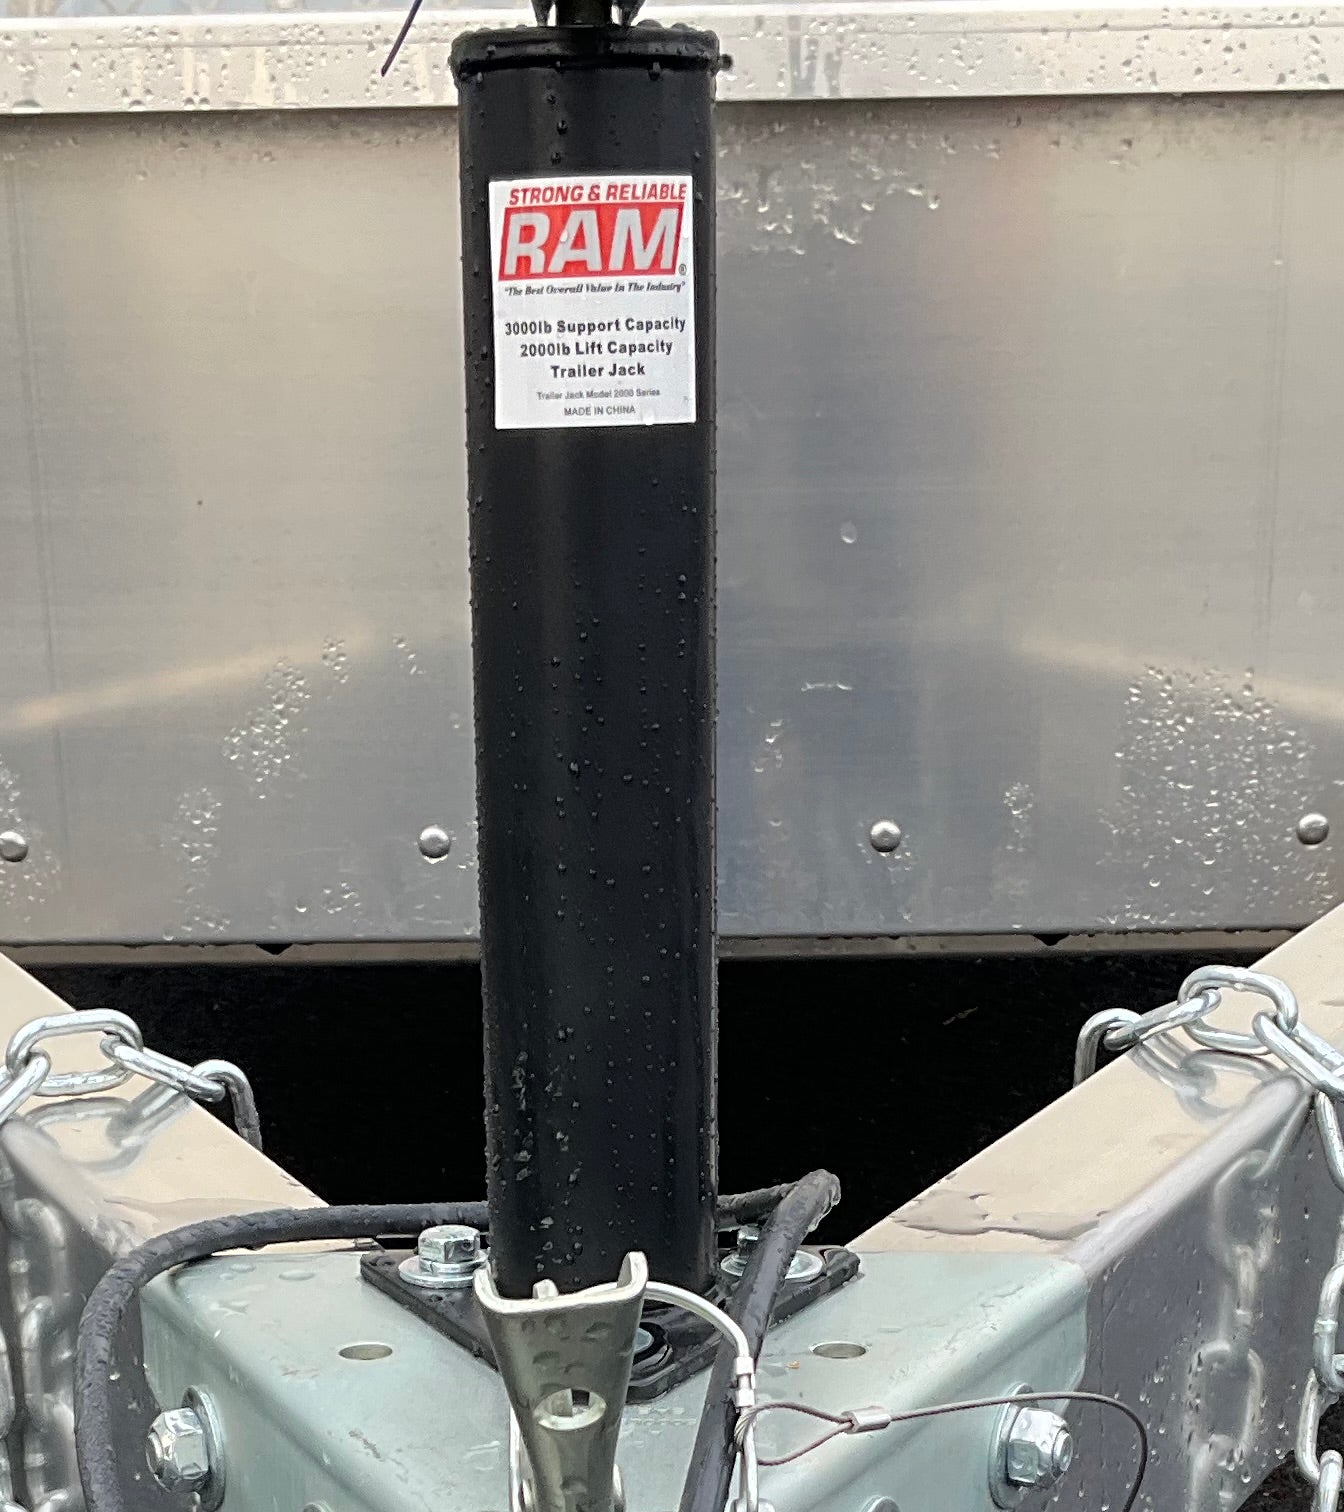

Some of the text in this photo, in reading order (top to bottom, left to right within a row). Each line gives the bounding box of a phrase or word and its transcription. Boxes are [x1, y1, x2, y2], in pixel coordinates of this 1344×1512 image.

[509, 184, 687, 205] STRONG & RELIABLE
[506, 208, 679, 275] RAM
[525, 285, 544, 295] Best
[546, 283, 582, 294] Overall
[586, 283, 612, 293] Value
[627, 281, 644, 292] The
[505, 316, 686, 335] 3000lb Support Capacity
[520, 339, 673, 358] 2000lb Lift Capacity
[550, 362, 646, 379] Trailer Jack
[537, 391, 563, 400] Trailer
[565, 390, 583, 399] Jack
[586, 390, 612, 399] Model
[636, 388, 660, 398] Series
[564, 405, 636, 416] MADE IN CHINA
